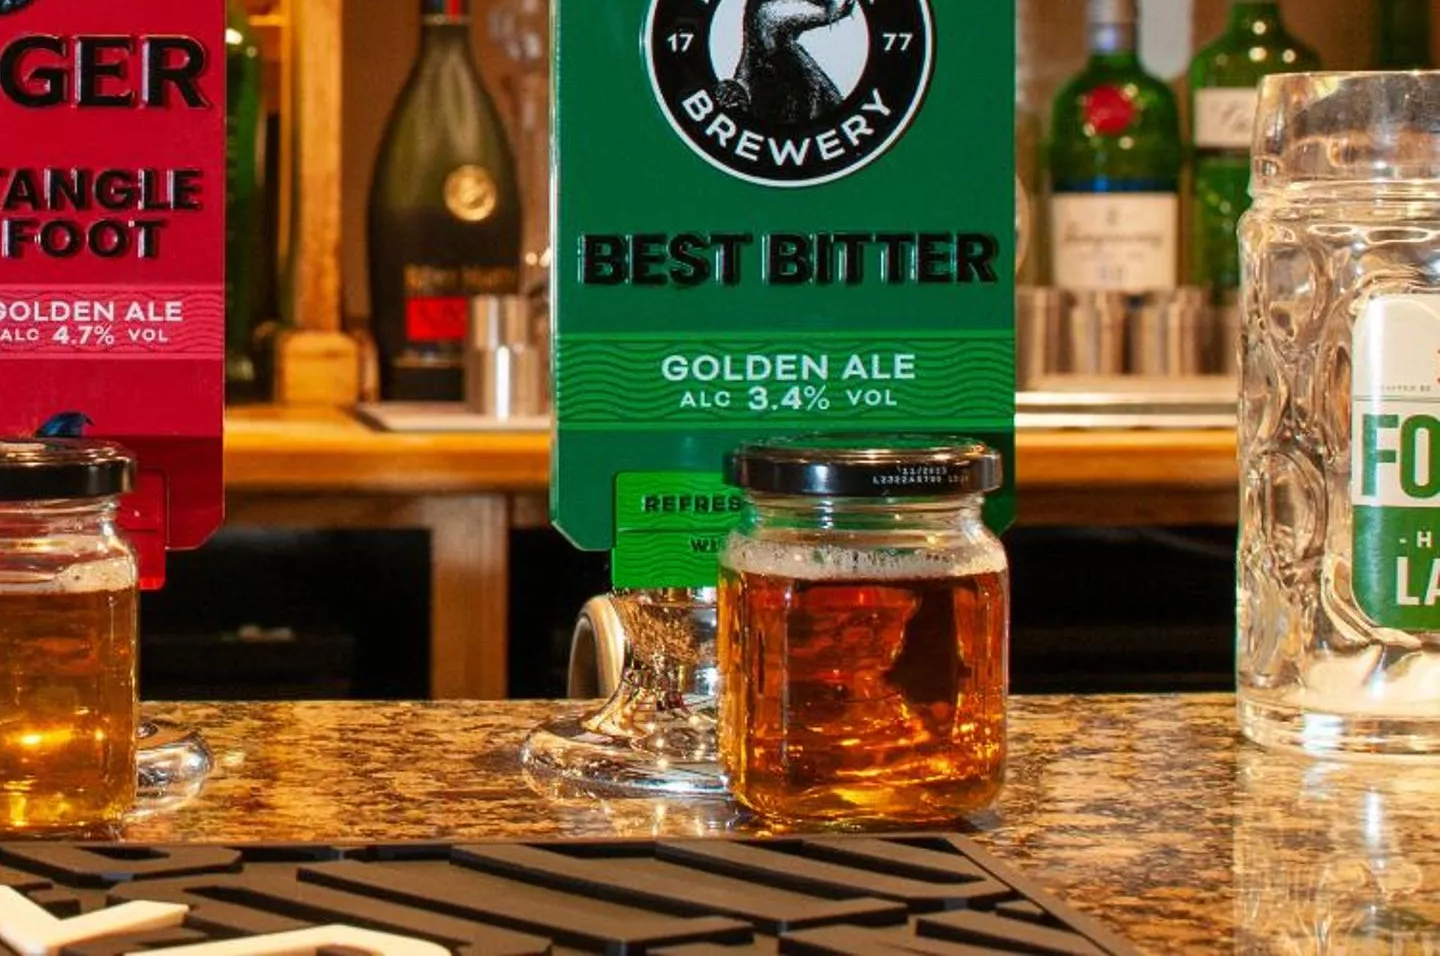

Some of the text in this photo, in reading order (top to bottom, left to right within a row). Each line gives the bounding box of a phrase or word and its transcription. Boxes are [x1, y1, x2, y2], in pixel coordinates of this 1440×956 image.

[666, 32, 914, 54] 17 77
[681, 87, 893, 168] BREWERY
[1, 217, 167, 260] FOOT
[577, 230, 754, 288] BEST
[762, 230, 1000, 288] BITTER
[124, 300, 184, 323] ALE
[0, 324, 169, 347] ALC 4.7% VOL
[661, 353, 917, 382] GOLDEN ALE
[680, 384, 898, 412] ALC 3.4% VOL
[641, 493, 742, 513] REFRES
[689, 536, 721, 554] WI
